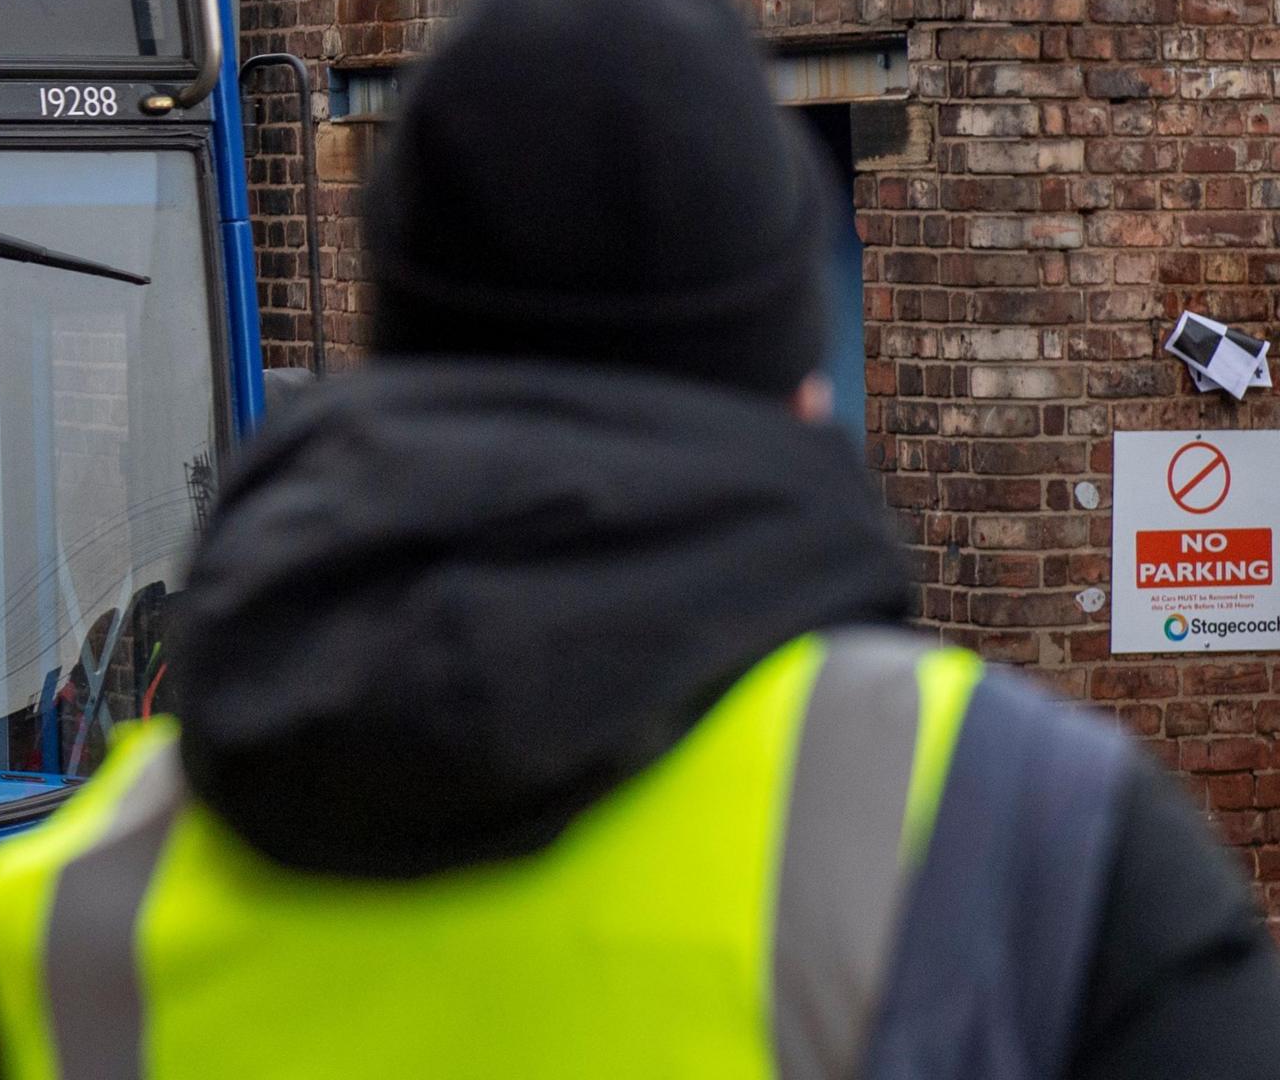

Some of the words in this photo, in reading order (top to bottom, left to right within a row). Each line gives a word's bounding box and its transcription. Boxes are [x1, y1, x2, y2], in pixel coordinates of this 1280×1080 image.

[40, 86, 117, 117] 19288
[1181, 532, 1228, 554] NO
[1140, 560, 1269, 583] PARKING
